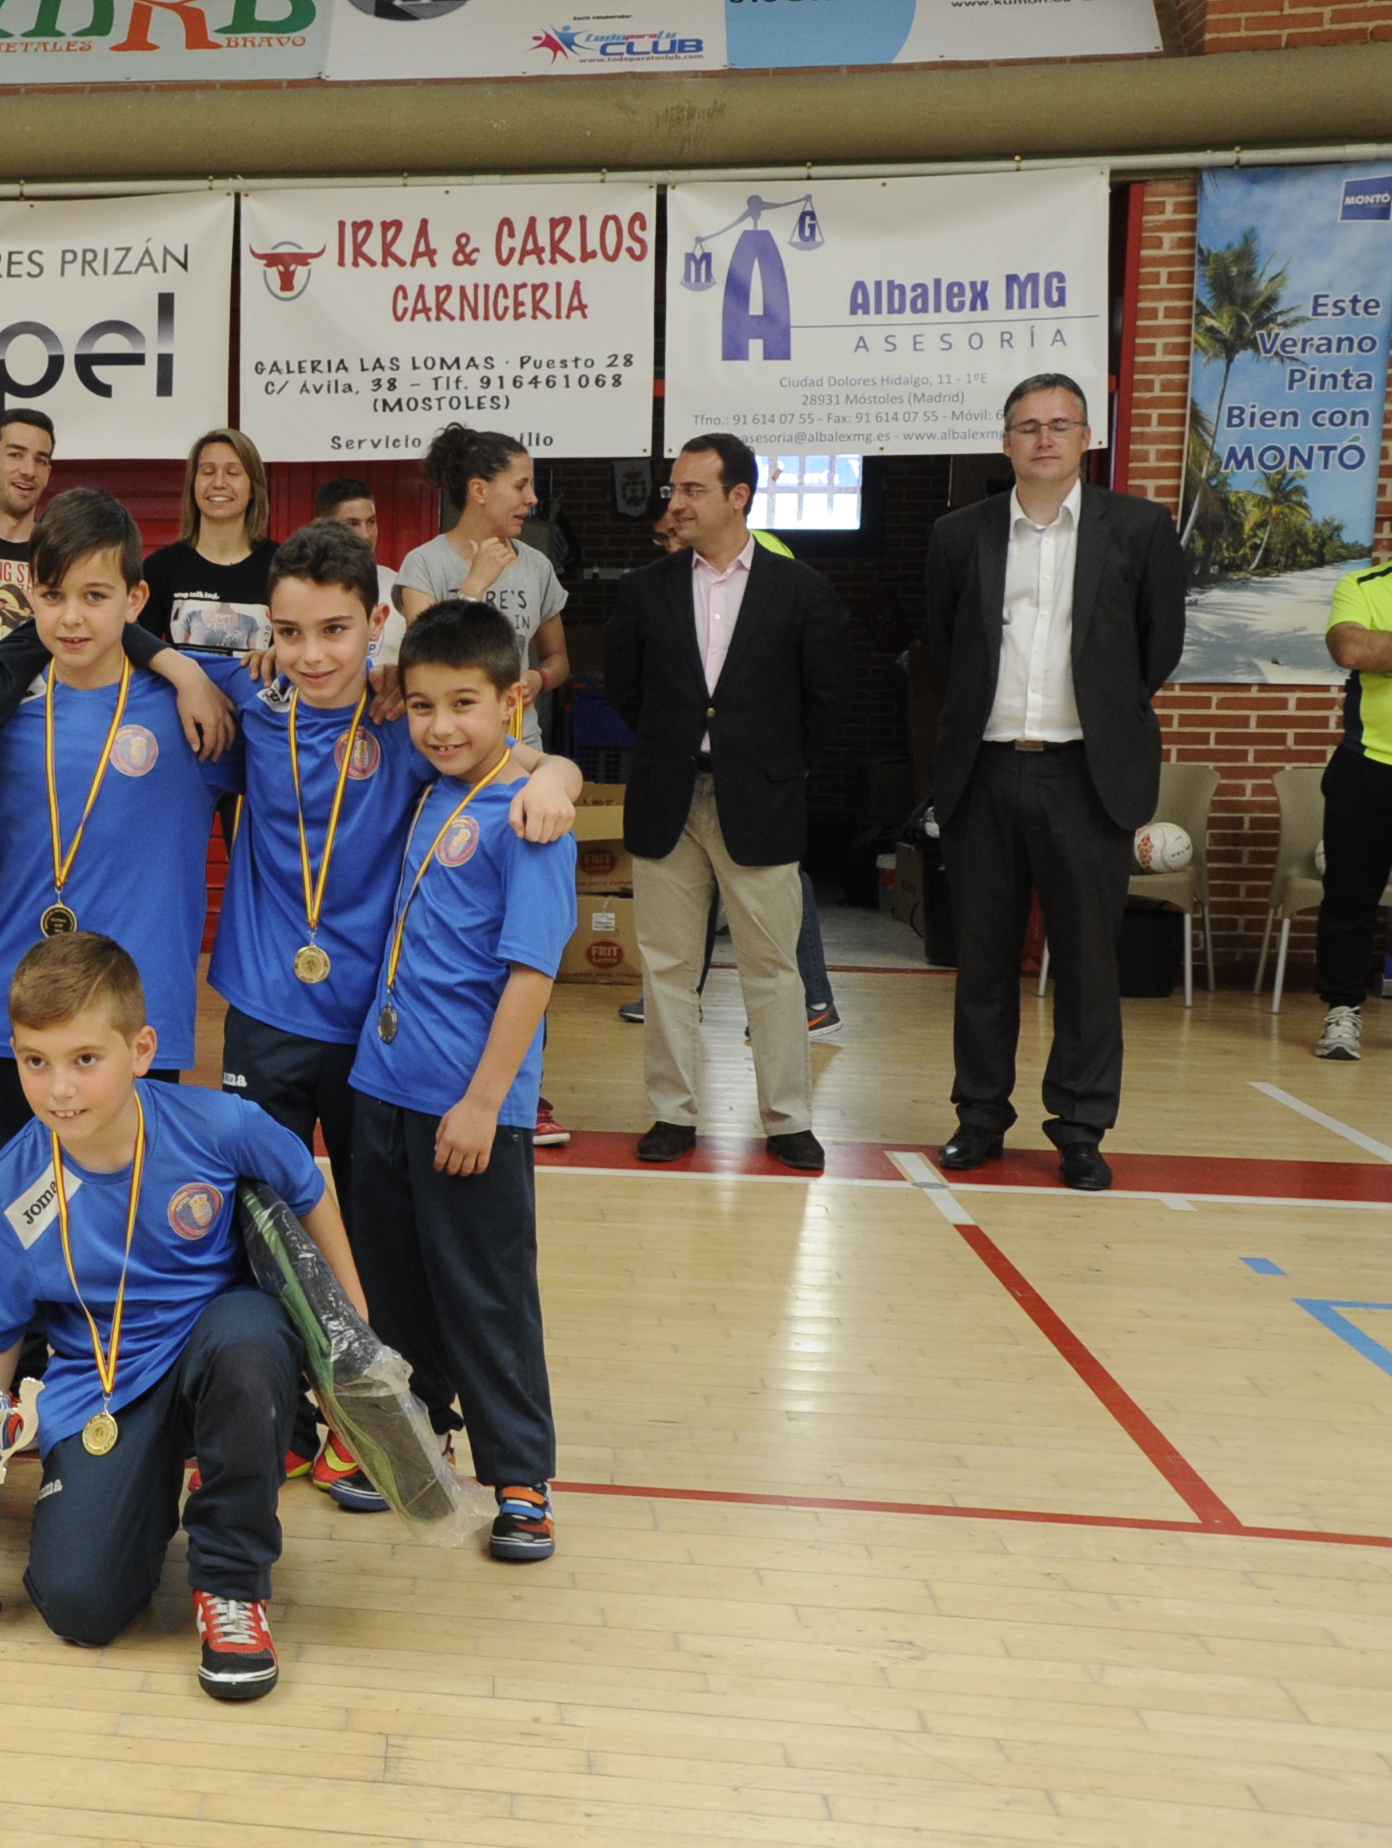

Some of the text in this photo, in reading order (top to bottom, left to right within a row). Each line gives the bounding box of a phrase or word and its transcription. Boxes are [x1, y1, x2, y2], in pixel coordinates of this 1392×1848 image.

[599, 39, 704, 56] CLUB
[798, 210, 817, 243] G
[337, 212, 648, 267] IRRA & CARLOS
[60, 237, 189, 278] PRIZÁN
[684, 251, 713, 283] M
[392, 280, 588, 322] CARNICERIA
[721, 229, 792, 361] A
[849, 271, 1067, 316] Albalex MG
[1311, 294, 1381, 318] Este
[853, 325, 1068, 354] ASESORÍA
[1257, 332, 1377, 356] Verano
[254, 358, 350, 375] GALERIA
[360, 356, 401, 373] LAS
[411, 355, 496, 372] LOMAS
[520, 355, 595, 370] Puesto
[605, 353, 635, 369] 28
[264, 380, 290, 396] C/
[370, 377, 398, 393] 38
[432, 375, 469, 391] Tlf.
[479, 373, 624, 390] 916461068
[779, 375, 825, 389] Ciudad
[827, 374, 878, 388] Dolores
[880, 373, 933, 389] Hidalgo,
[936, 374, 952, 386] 11
[1287, 367, 1375, 391] Pinta
[372, 395, 512, 413] (MOSTOLES)
[801, 389, 966, 407] 28931 Móstoles (Madrid)
[732, 414, 748, 426] 91
[752, 413, 776, 426] 614
[779, 413, 795, 425] 07
[799, 413, 815, 425] 55
[827, 411, 852, 425] Fax:
[855, 411, 871, 424] 91
[874, 410, 899, 424] 614
[902, 410, 919, 423] 07
[922, 410, 939, 423] 55
[951, 409, 992, 421] Móvil:
[1225, 405, 1370, 429] Bien con
[330, 435, 422, 450] Servicio
[1221, 435, 1367, 472] MONTÓ
[591, 946, 619, 957] FRIT
